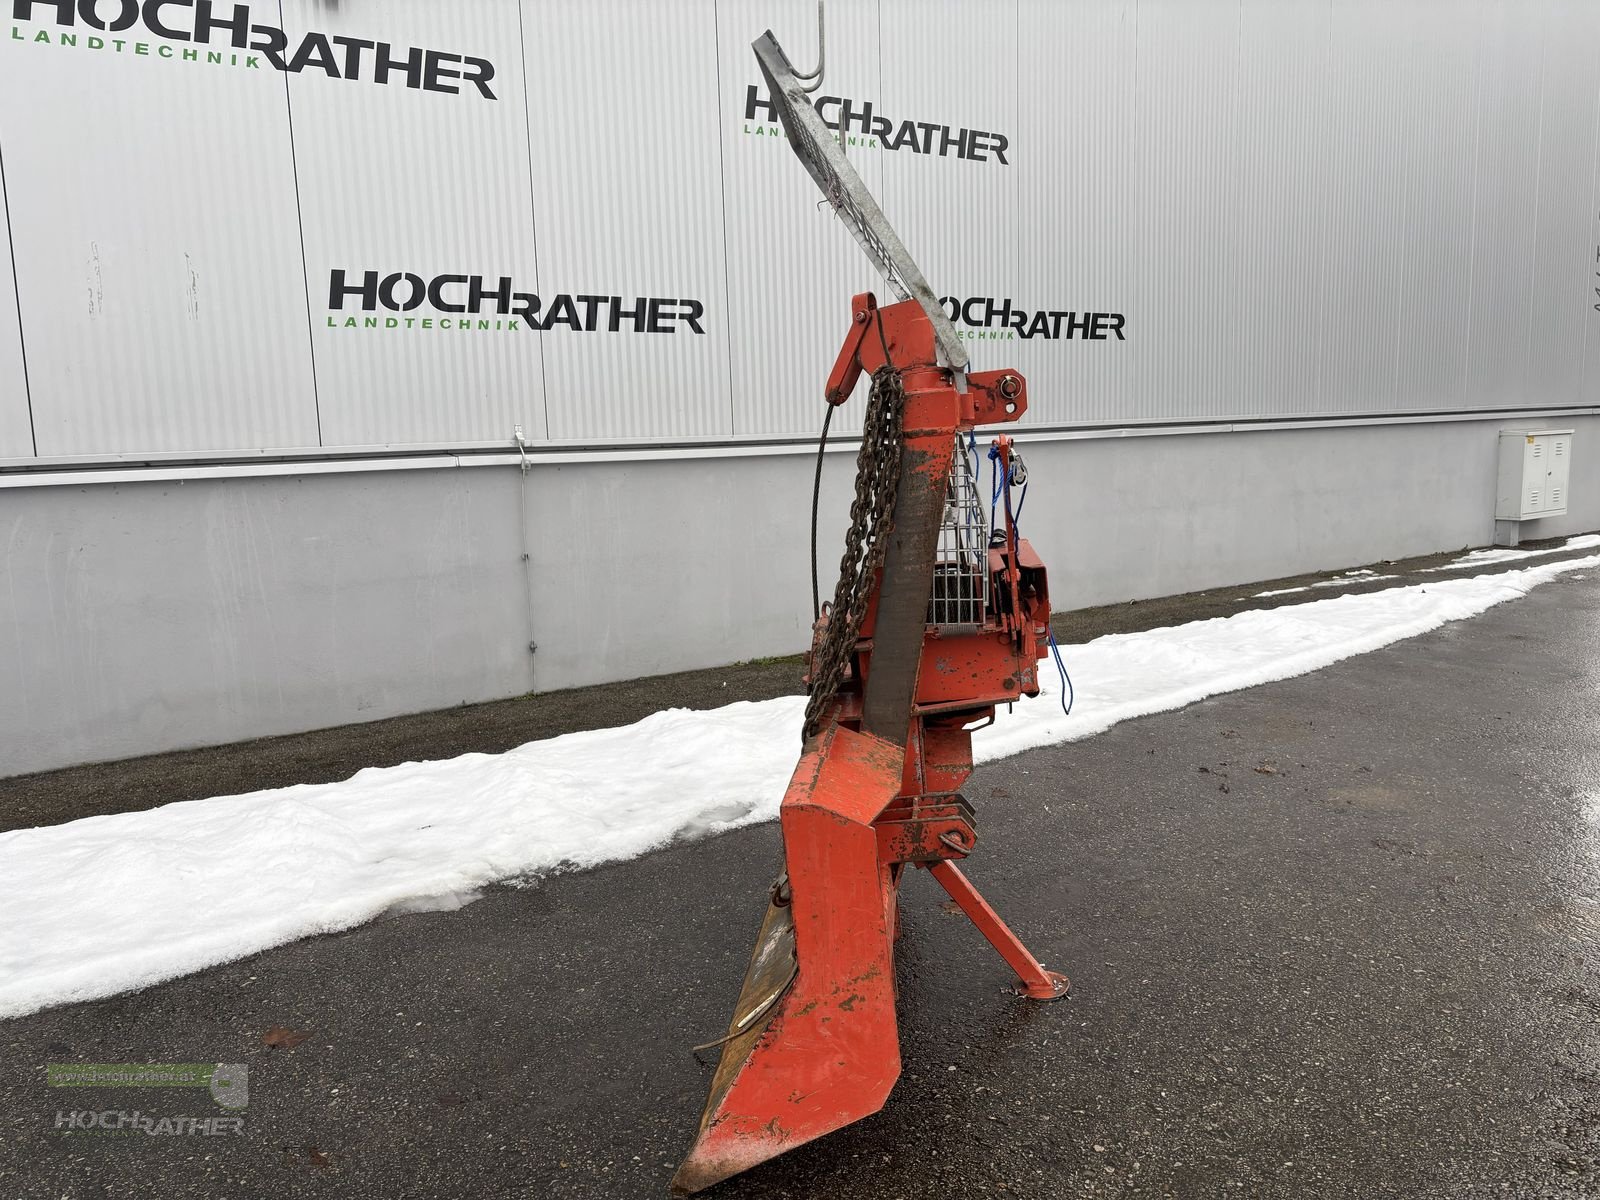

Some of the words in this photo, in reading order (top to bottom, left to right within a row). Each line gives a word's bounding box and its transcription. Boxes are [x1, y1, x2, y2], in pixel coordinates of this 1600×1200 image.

[12, 27, 260, 69] LANDTECHNIK
[745, 85, 1008, 165] HCHRATHER
[327, 316, 519, 331] LANDTECHNIK
[328, 269, 705, 334] HOCHRATHER
[939, 296, 1125, 341] OCHRATHER
